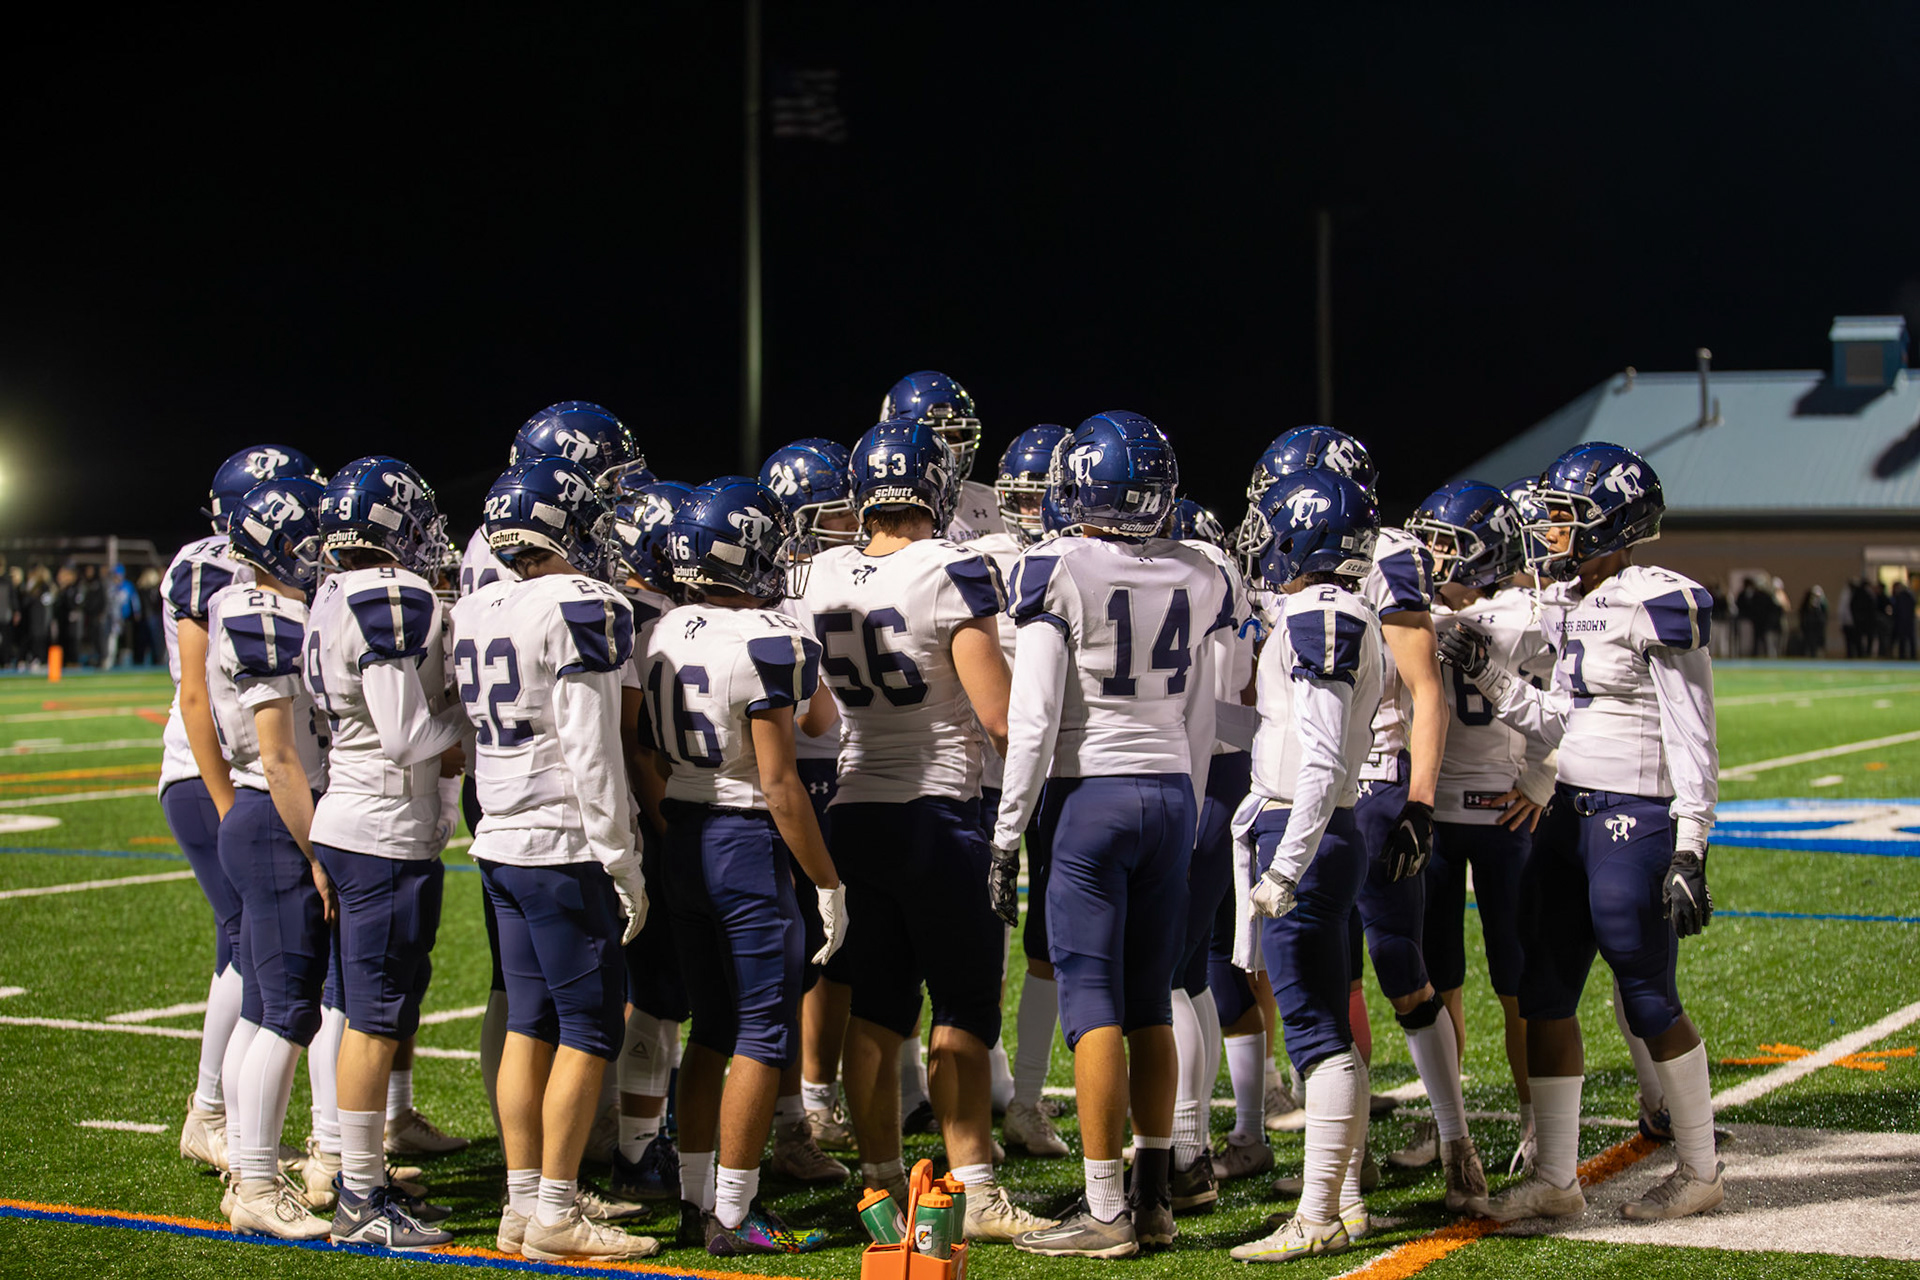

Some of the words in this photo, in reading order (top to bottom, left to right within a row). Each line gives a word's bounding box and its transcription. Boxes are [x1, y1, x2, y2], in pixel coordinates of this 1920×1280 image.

[868, 452, 907, 478] 53
[874, 485, 913, 498] schutt
[1139, 491, 1161, 515] 14
[338, 496, 353, 521] 9
[489, 494, 512, 521] 22
[327, 530, 358, 543] schutt
[492, 532, 520, 545] schutt
[671, 535, 690, 560] 16
[248, 589, 281, 609] 21
[1318, 586, 1338, 602] 2
[759, 613, 800, 630] 16
[1576, 619, 1608, 632] BROWN
[1102, 588, 1192, 696] 14
[813, 606, 929, 707] 56
[454, 637, 535, 747] 22
[648, 660, 724, 769] 16
[915, 1224, 933, 1250] G
